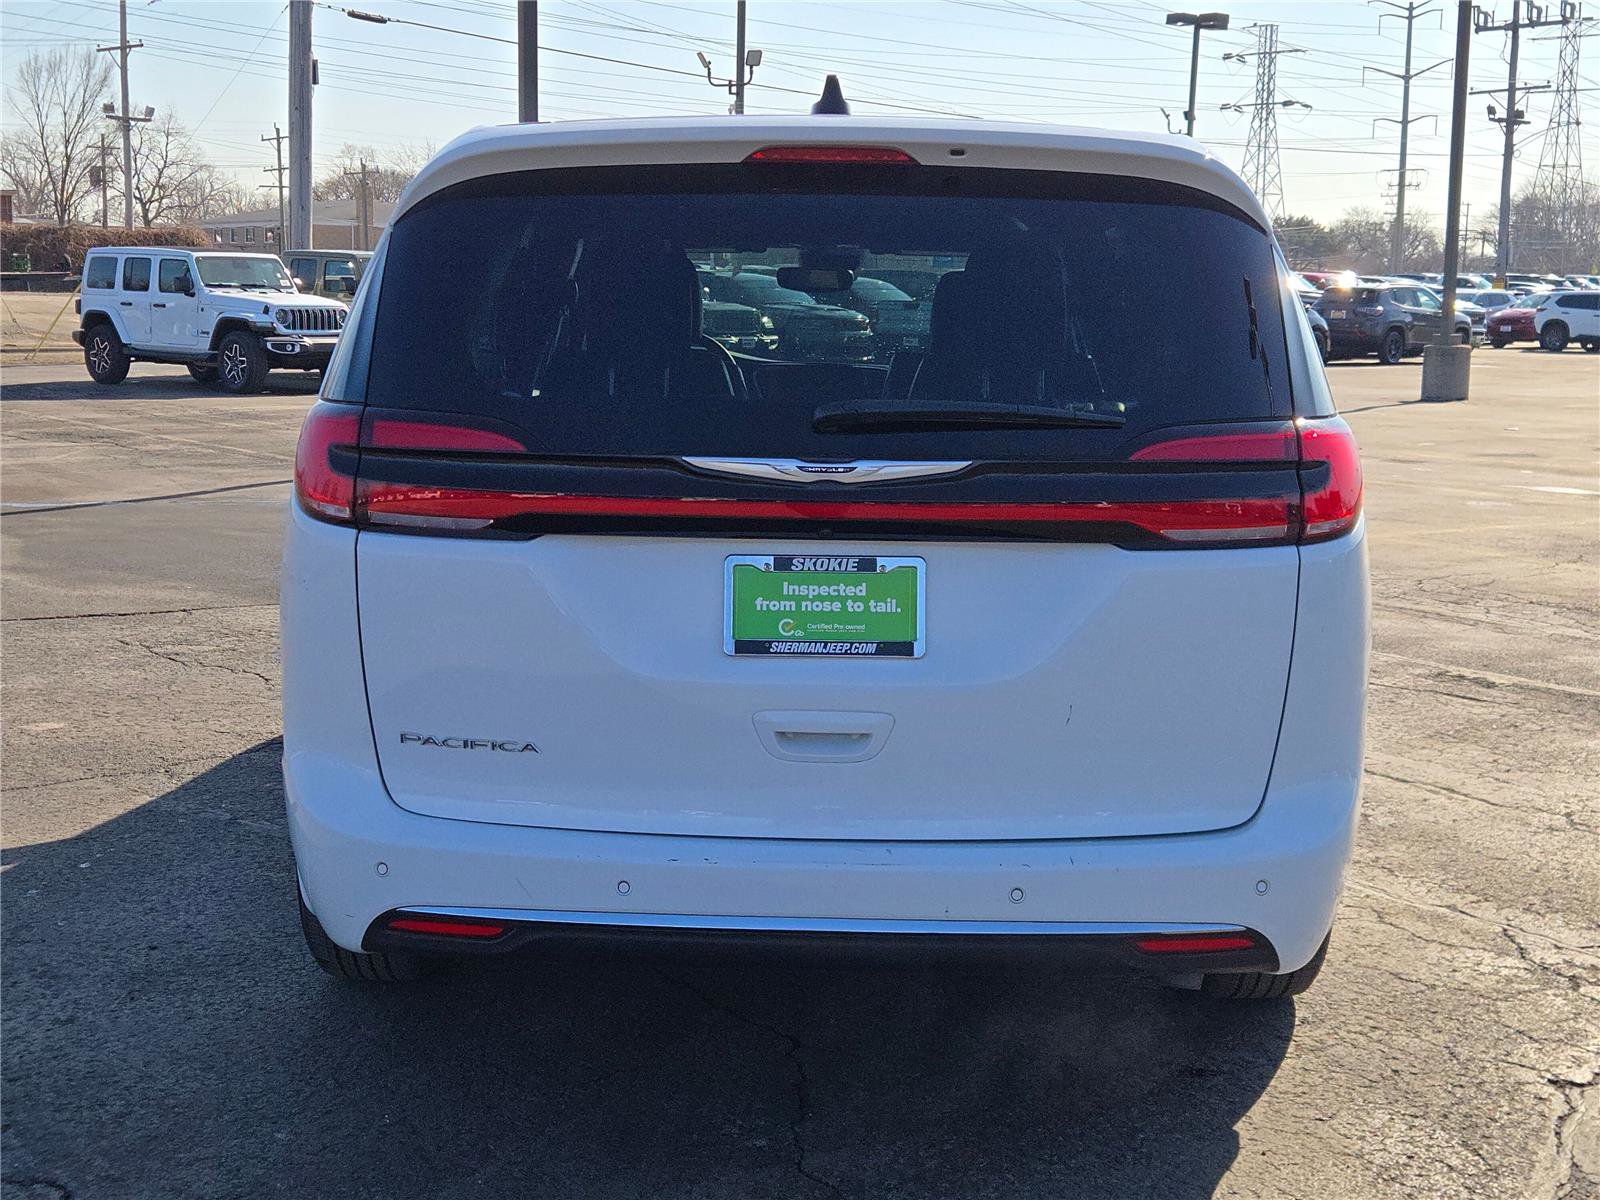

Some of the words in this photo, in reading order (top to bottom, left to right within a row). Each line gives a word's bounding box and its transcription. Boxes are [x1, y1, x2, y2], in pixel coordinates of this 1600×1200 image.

[790, 558, 859, 572] SKOKIE
[782, 581, 867, 598] Inspected
[754, 597, 796, 611] from
[801, 599, 842, 612] nose
[846, 599, 865, 612] to
[868, 598, 902, 613] tail.
[770, 641, 878, 654] SHERMANJEEP.COM
[400, 731, 541, 754] PACIFICA
